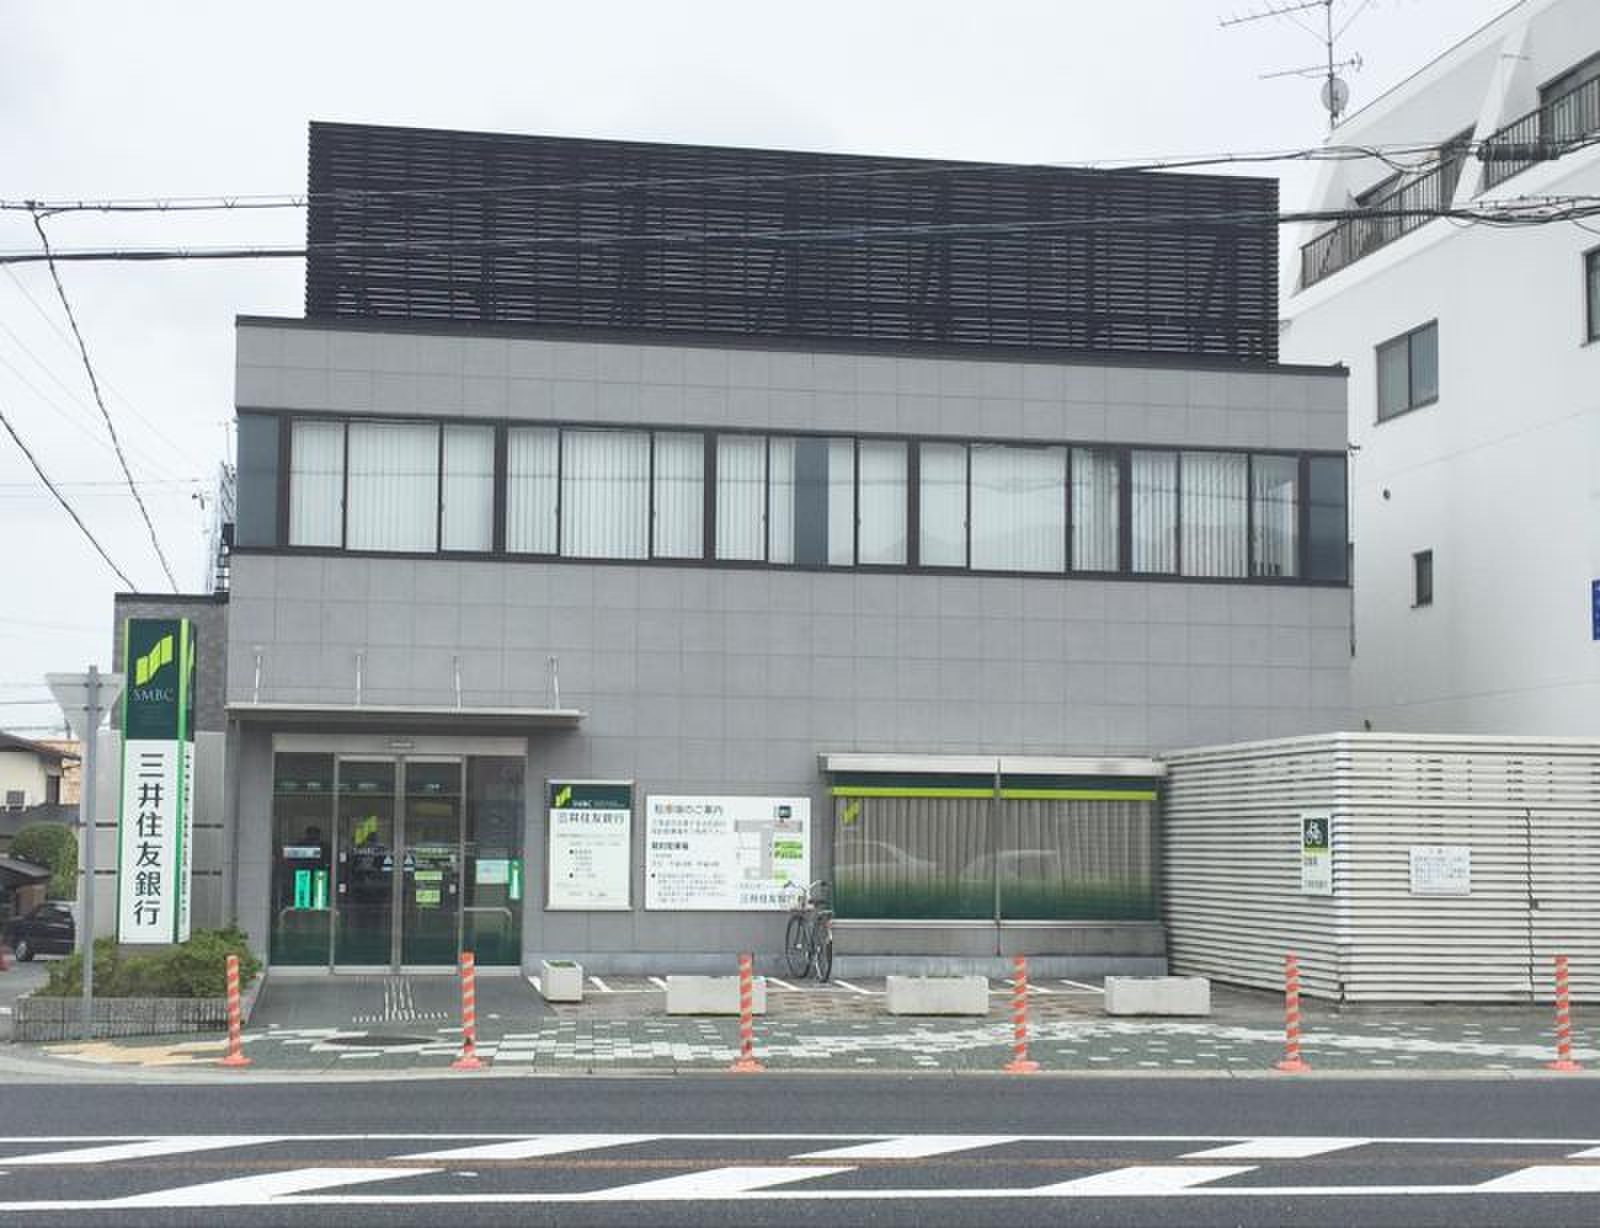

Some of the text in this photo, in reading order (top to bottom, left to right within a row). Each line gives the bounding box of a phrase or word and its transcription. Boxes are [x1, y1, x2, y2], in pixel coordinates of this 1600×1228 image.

[133, 688, 174, 702] SMBC
[133, 753, 165, 926] 三井住友銀行
